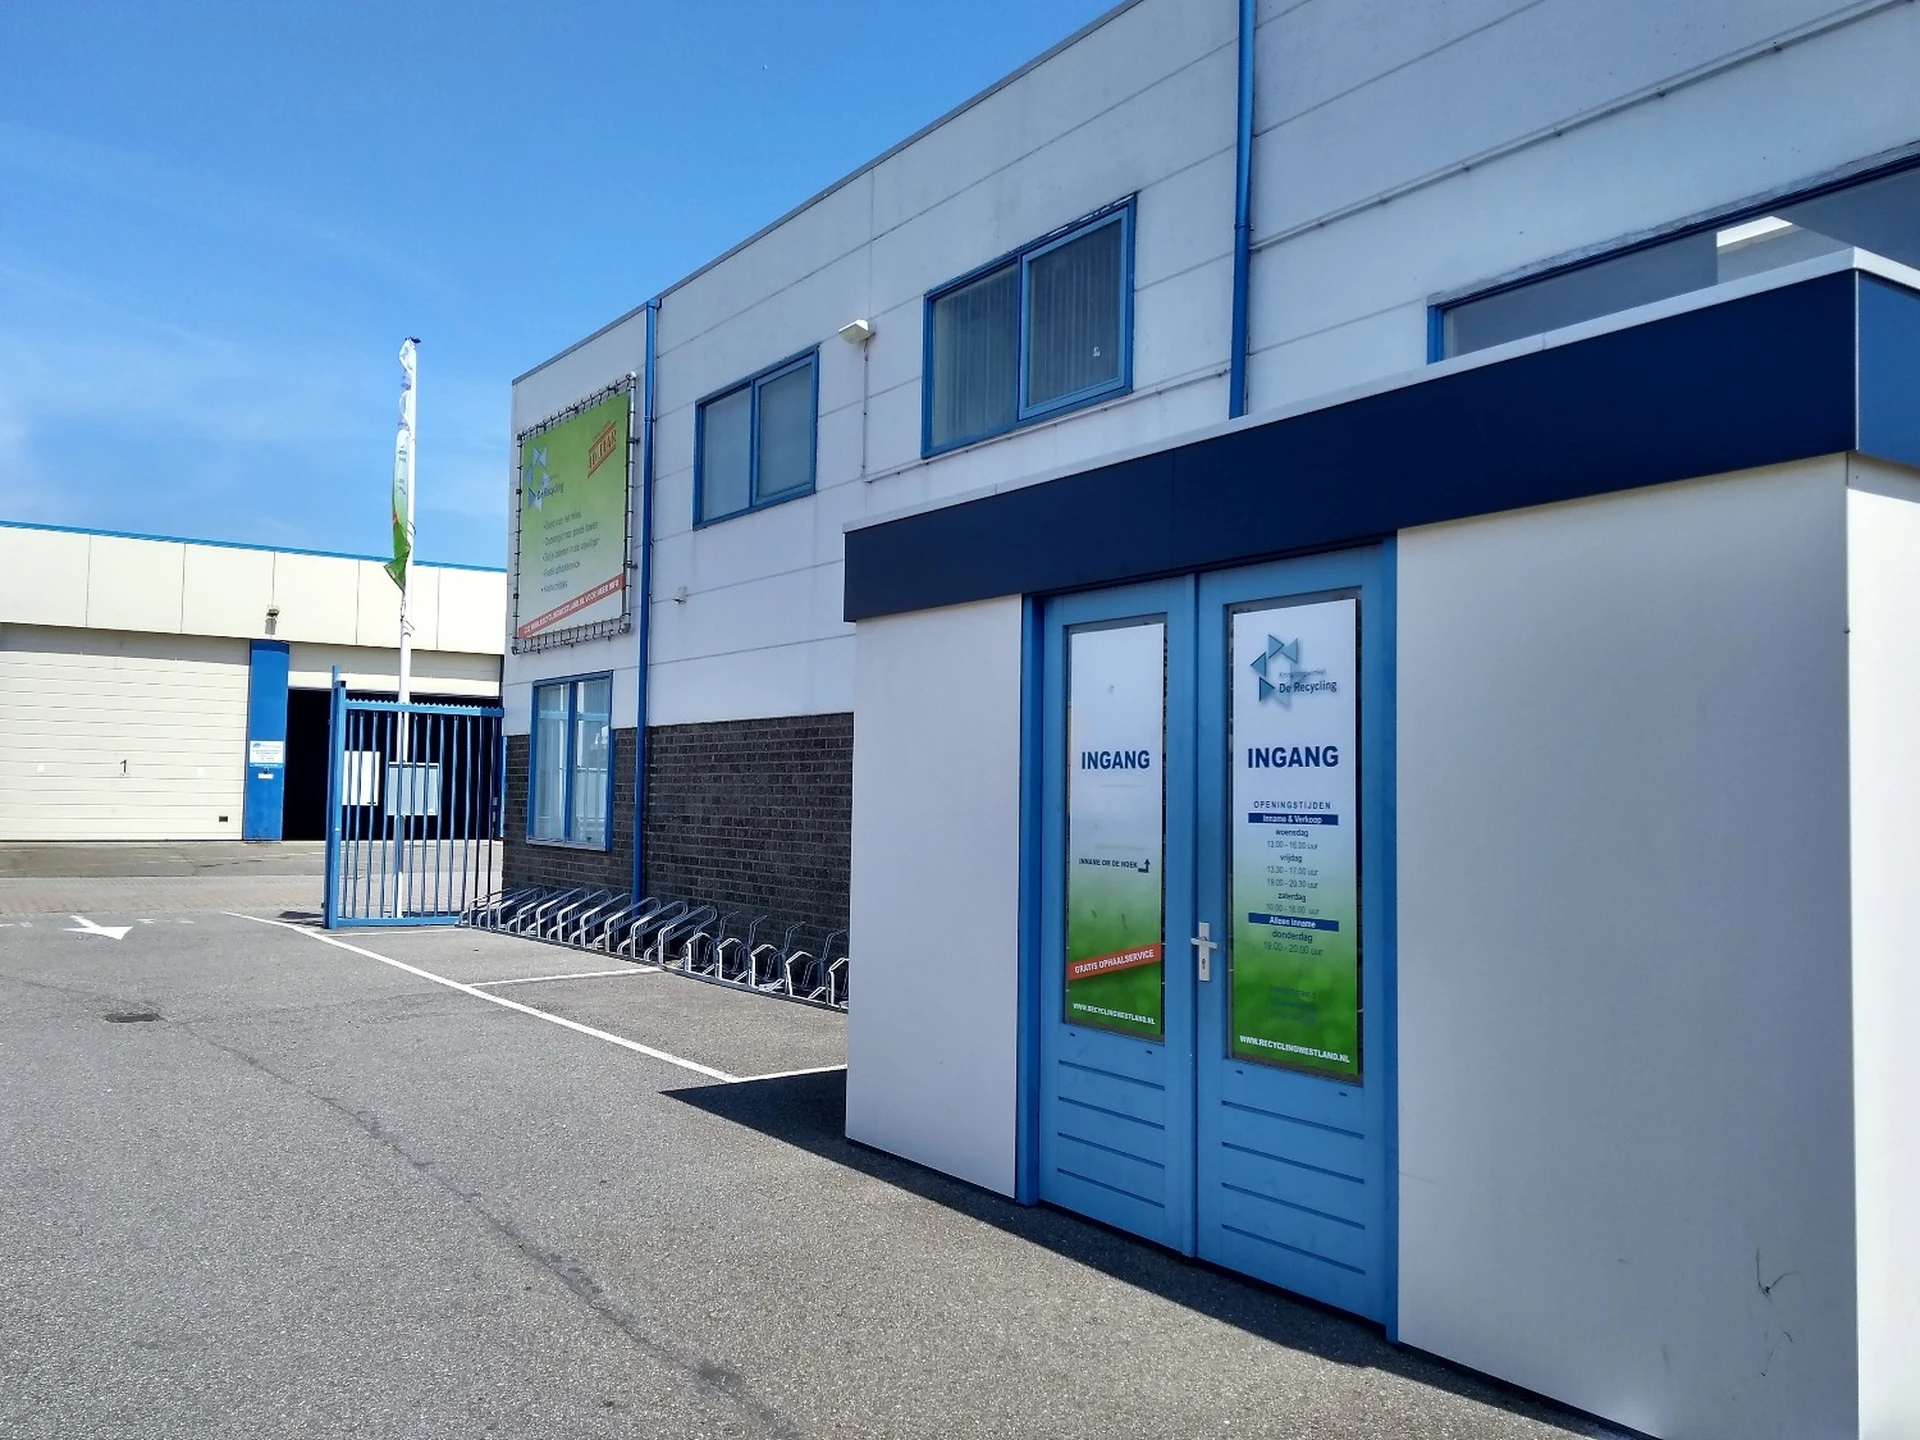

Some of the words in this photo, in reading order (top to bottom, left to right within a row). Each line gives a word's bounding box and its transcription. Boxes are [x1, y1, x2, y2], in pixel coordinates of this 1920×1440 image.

[1279, 683, 1292, 694] De
[1293, 680, 1337, 694] Recycling
[1081, 750, 1150, 770] INGANG
[1248, 745, 1339, 768] INGANG
[119, 759, 127, 773] 1
[1254, 800, 1331, 810] OPENINGSTIJDEN
[1263, 814, 1287, 822] Inname
[1287, 815, 1293, 823] &
[1294, 815, 1323, 824] Verkoop
[1276, 829, 1309, 837] woensdag
[1101, 859, 1111, 867] OM
[1121, 861, 1138, 869] HOEK
[1280, 854, 1303, 863] vrijdag
[1278, 893, 1306, 903] zaterdag
[1272, 930, 1313, 944] donderdag
[1311, 948, 1323, 956] uur
[1074, 962, 1098, 974] GRATIS
[1098, 949, 1154, 969] OPHAALSERVICE
[1073, 1002, 1155, 1025] WWW.RECYCLINGWESTLAND.NL
[1239, 1035, 1351, 1063] WWW.RECYCLINGWESTLAND.NL
